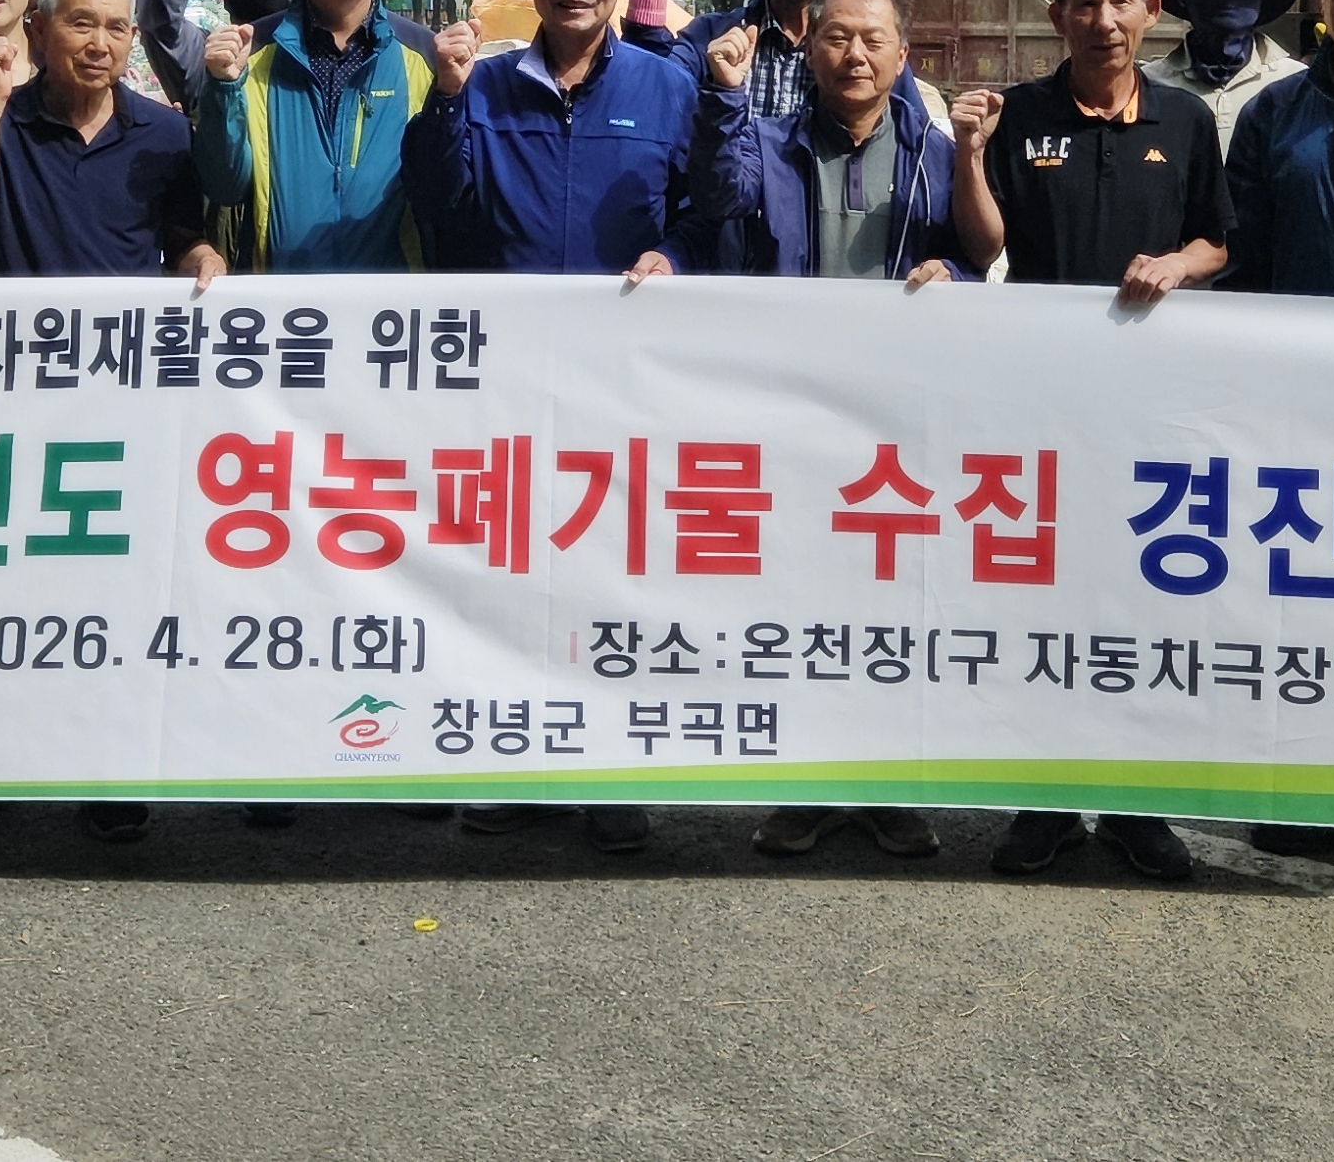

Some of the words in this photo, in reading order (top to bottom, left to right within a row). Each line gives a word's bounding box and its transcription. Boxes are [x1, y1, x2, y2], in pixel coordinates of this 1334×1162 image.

[365, 308, 488, 391] 위한
[197, 431, 773, 576] 영농폐기물
[831, 443, 1058, 586] 수집
[146, 615, 199, 670] 4.
[431, 698, 586, 756] 창녕군
[627, 701, 778, 756] 부곡면
[334, 752, 401, 762] CHANGNYEONG
